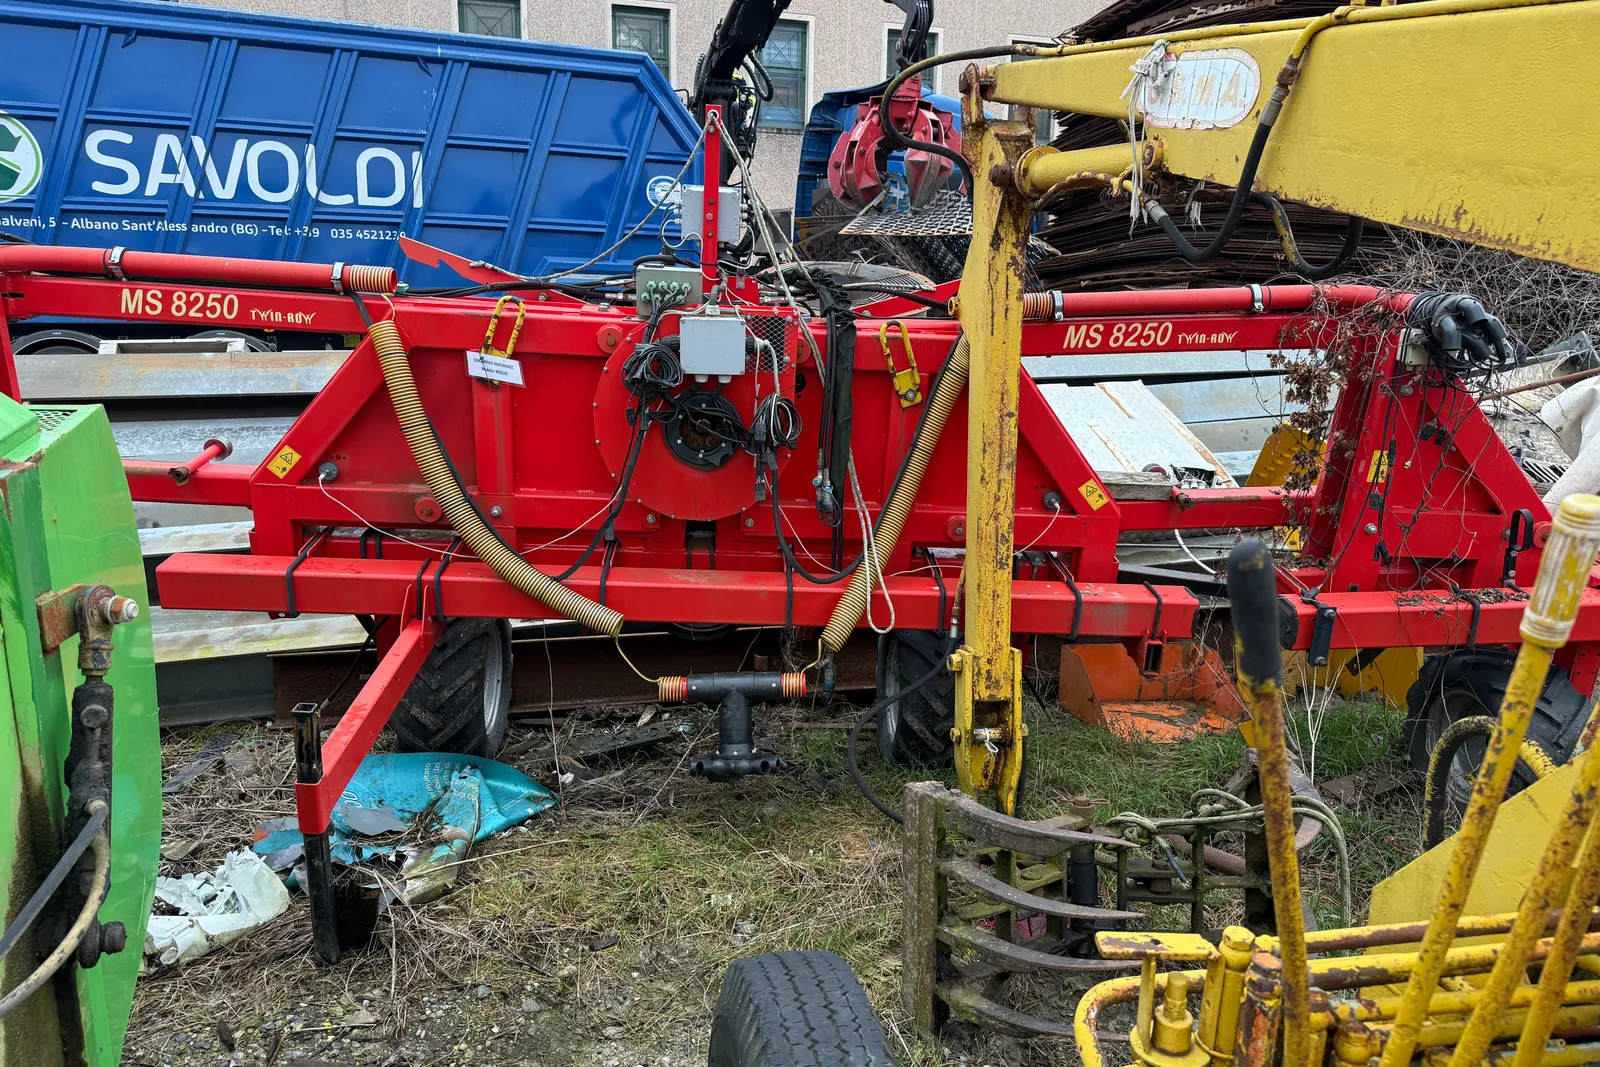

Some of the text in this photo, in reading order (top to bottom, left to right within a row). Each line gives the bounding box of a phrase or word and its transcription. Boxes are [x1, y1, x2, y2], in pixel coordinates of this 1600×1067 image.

[85, 129, 423, 209] SAVOLDI
[49, 217, 56, 227] 5
[71, 217, 119, 231] Albano
[231, 223, 258, 236] (BG)
[330, 228, 353, 239] 035
[121, 288, 163, 316] MS
[170, 291, 239, 320] 8250
[1062, 323, 1104, 349] MS
[1108, 321, 1173, 348] 8250
